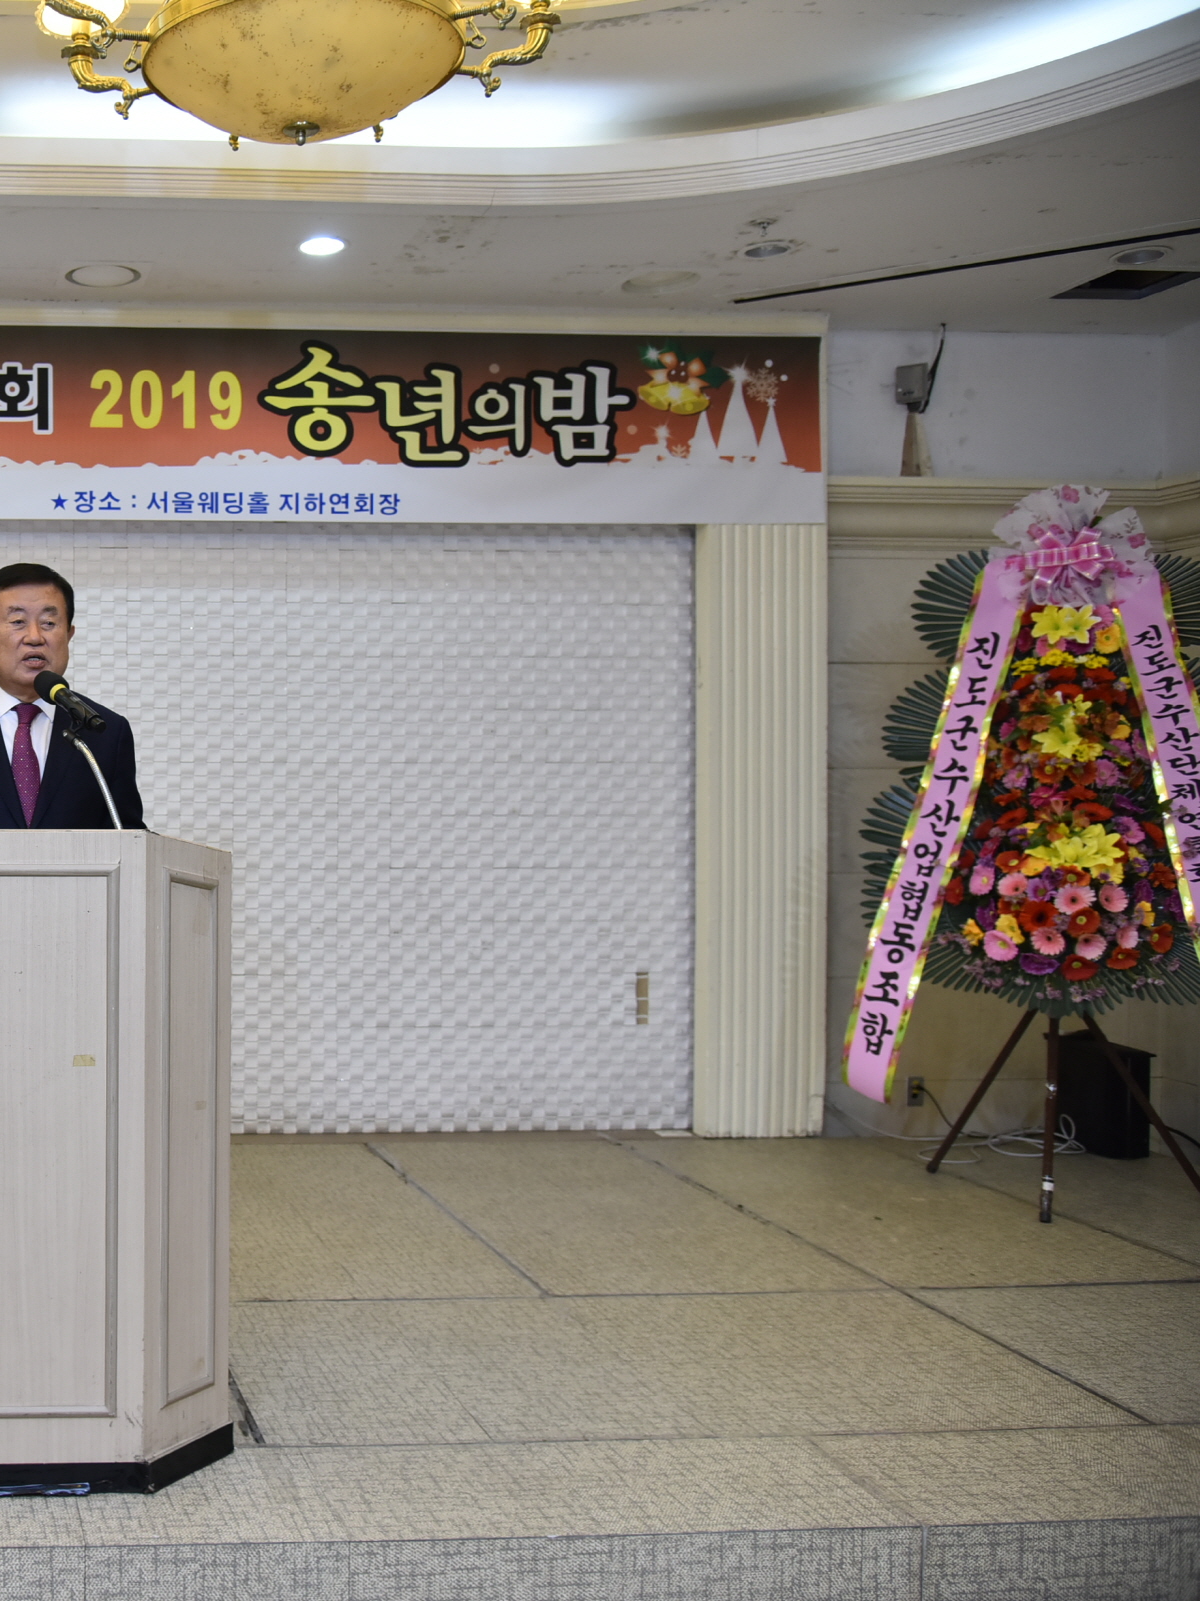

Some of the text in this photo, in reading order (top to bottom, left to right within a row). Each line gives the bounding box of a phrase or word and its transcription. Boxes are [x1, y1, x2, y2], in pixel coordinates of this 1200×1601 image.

[89, 369, 243, 430] 2019
[73, 490, 122, 513] 장소
[146, 490, 271, 515] 서울웨딩홀
[278, 492, 402, 516] 지하연회장
[860, 631, 1001, 1056] 진도군수산업협동조합
